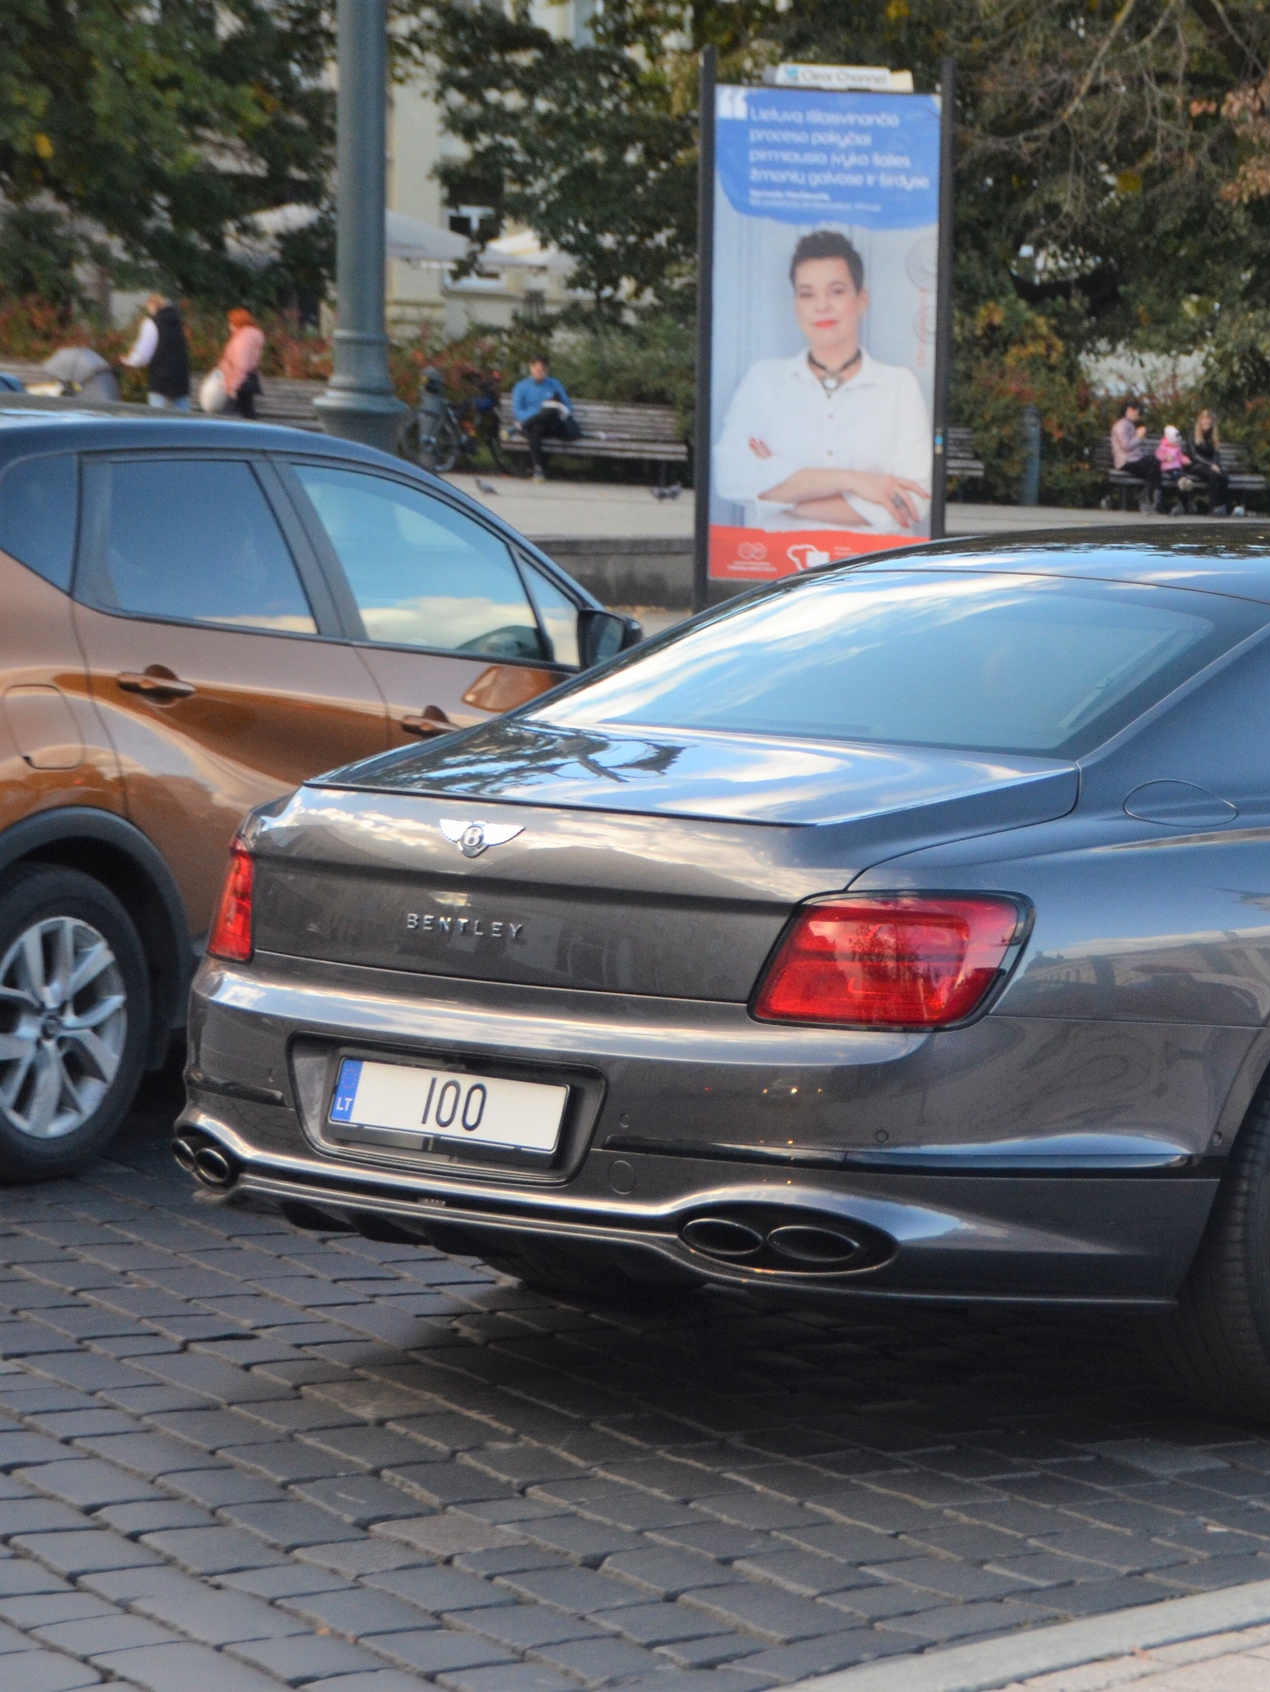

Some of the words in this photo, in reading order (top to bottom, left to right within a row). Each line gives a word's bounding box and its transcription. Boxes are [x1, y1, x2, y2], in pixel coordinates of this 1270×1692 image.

[800, 69, 832, 83] Clear
[835, 70, 887, 84] Channel
[407, 912, 523, 939] BENTLEY
[336, 1095, 354, 1112] LT
[420, 1076, 488, 1132] 100
